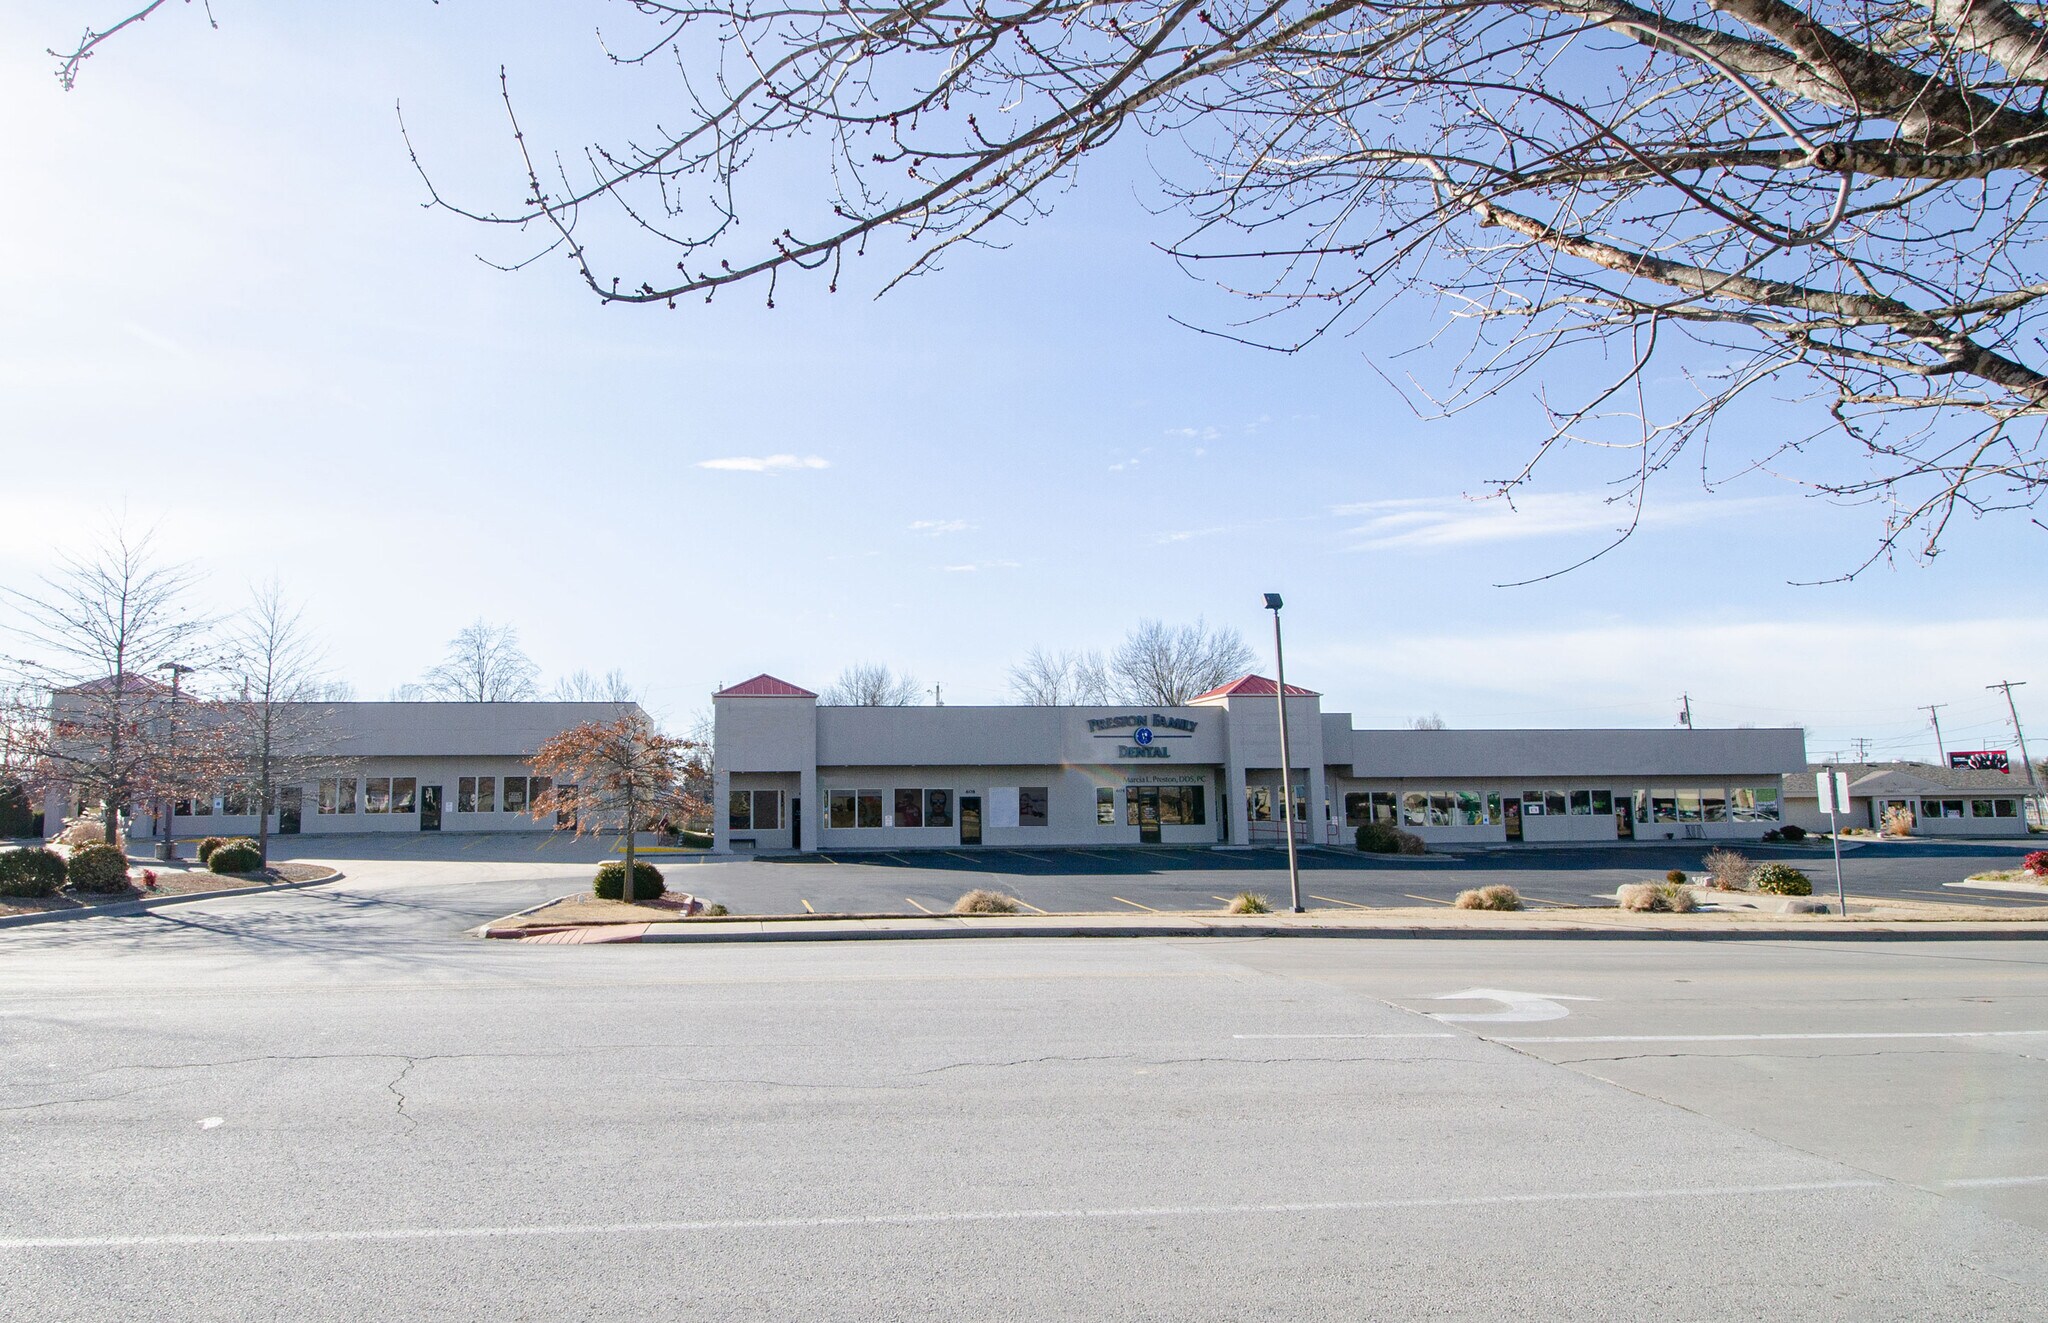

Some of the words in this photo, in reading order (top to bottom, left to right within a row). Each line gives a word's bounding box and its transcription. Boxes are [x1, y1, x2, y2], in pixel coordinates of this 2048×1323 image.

[1087, 715, 1148, 733] PRESTON
[1152, 713, 1198, 733] FAMILY
[1118, 745, 1171, 758] DENTAL
